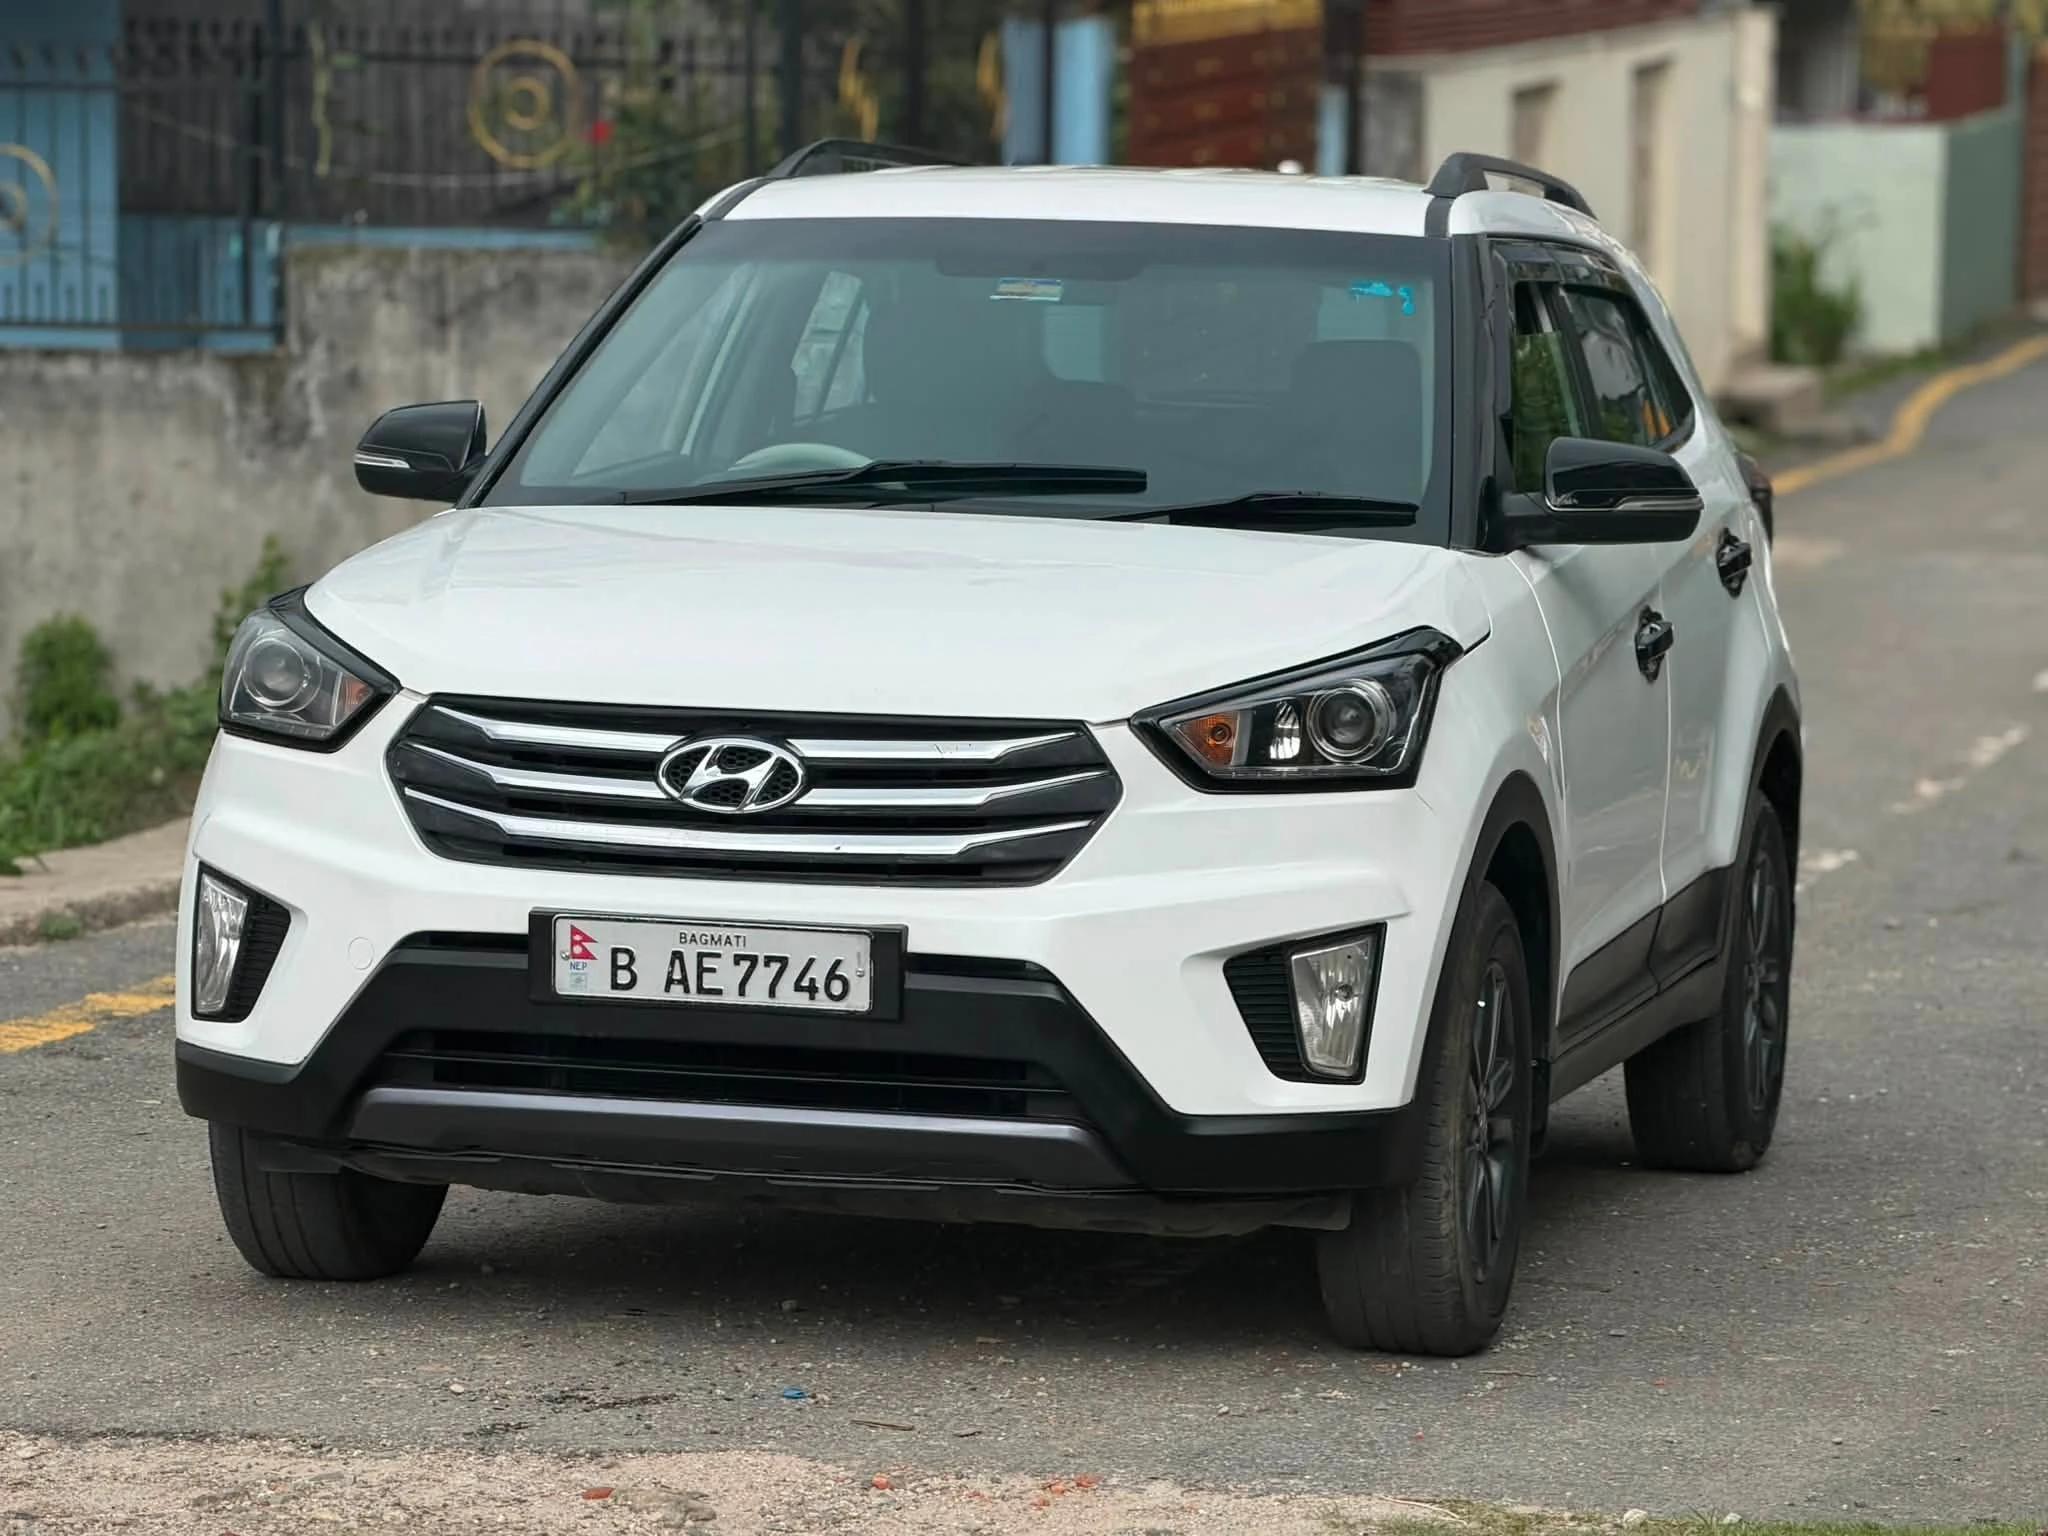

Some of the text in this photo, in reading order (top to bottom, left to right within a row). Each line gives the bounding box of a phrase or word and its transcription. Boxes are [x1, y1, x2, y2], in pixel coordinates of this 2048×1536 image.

[679, 931, 746, 948] BAGMATI
[569, 961, 588, 971] NEP
[610, 947, 850, 1002] B AE7746
